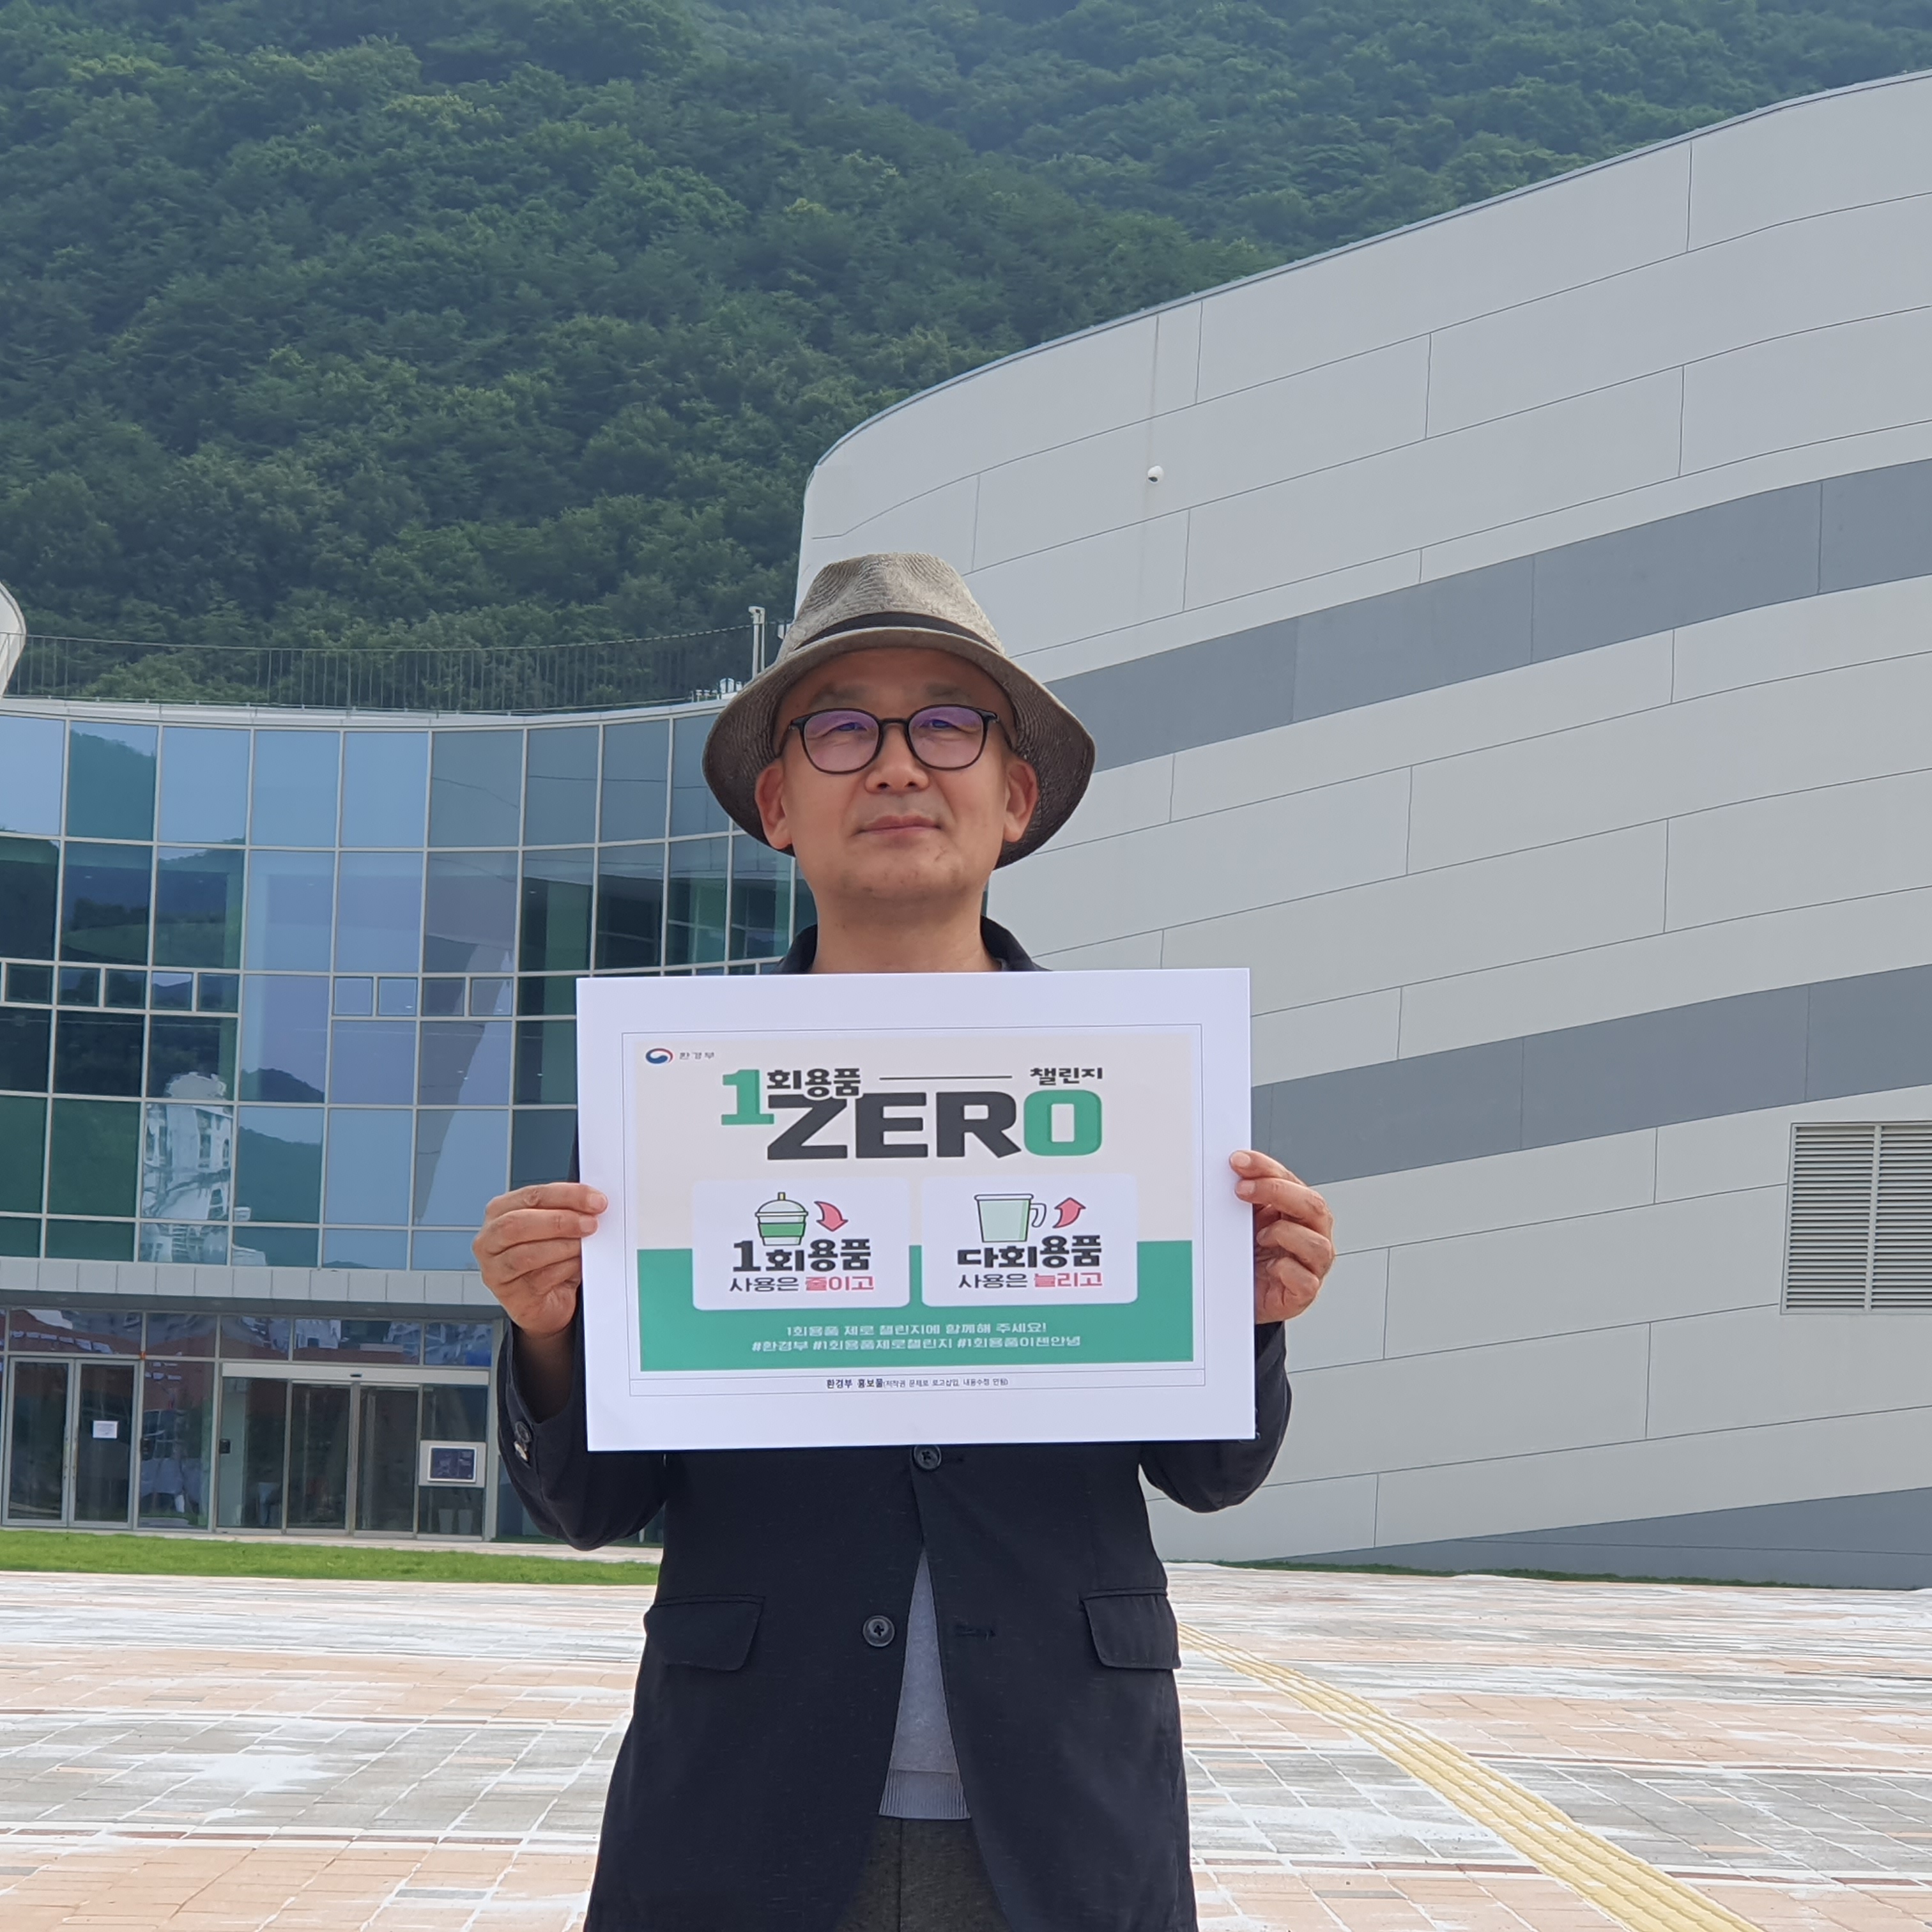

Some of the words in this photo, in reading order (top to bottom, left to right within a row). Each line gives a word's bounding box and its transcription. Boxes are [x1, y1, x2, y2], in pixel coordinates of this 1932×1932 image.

[679, 1052, 715, 1061] 환경부
[721, 1068, 861, 1126] 1회용품
[1030, 1068, 1103, 1085] 챌린지
[767, 1089, 1102, 1160] ZERO
[733, 1239, 871, 1272] 1회용품
[957, 1235, 1102, 1268] 다회용품
[730, 1277, 799, 1292] 사용은
[805, 1276, 874, 1291] 줄이고
[958, 1273, 1027, 1289] 사용은
[1034, 1272, 1103, 1287] 늘리고
[787, 1326, 839, 1337] 1회용품
[844, 1325, 874, 1335] 제로
[880, 1324, 940, 1335] 챌린지에
[946, 1323, 991, 1334] 함께해
[996, 1322, 1046, 1333] 주세요!
[752, 1340, 808, 1351] #환경부
[813, 1338, 952, 1351] #1회용품제로챌린지
[827, 1379, 853, 1389] 환경부
